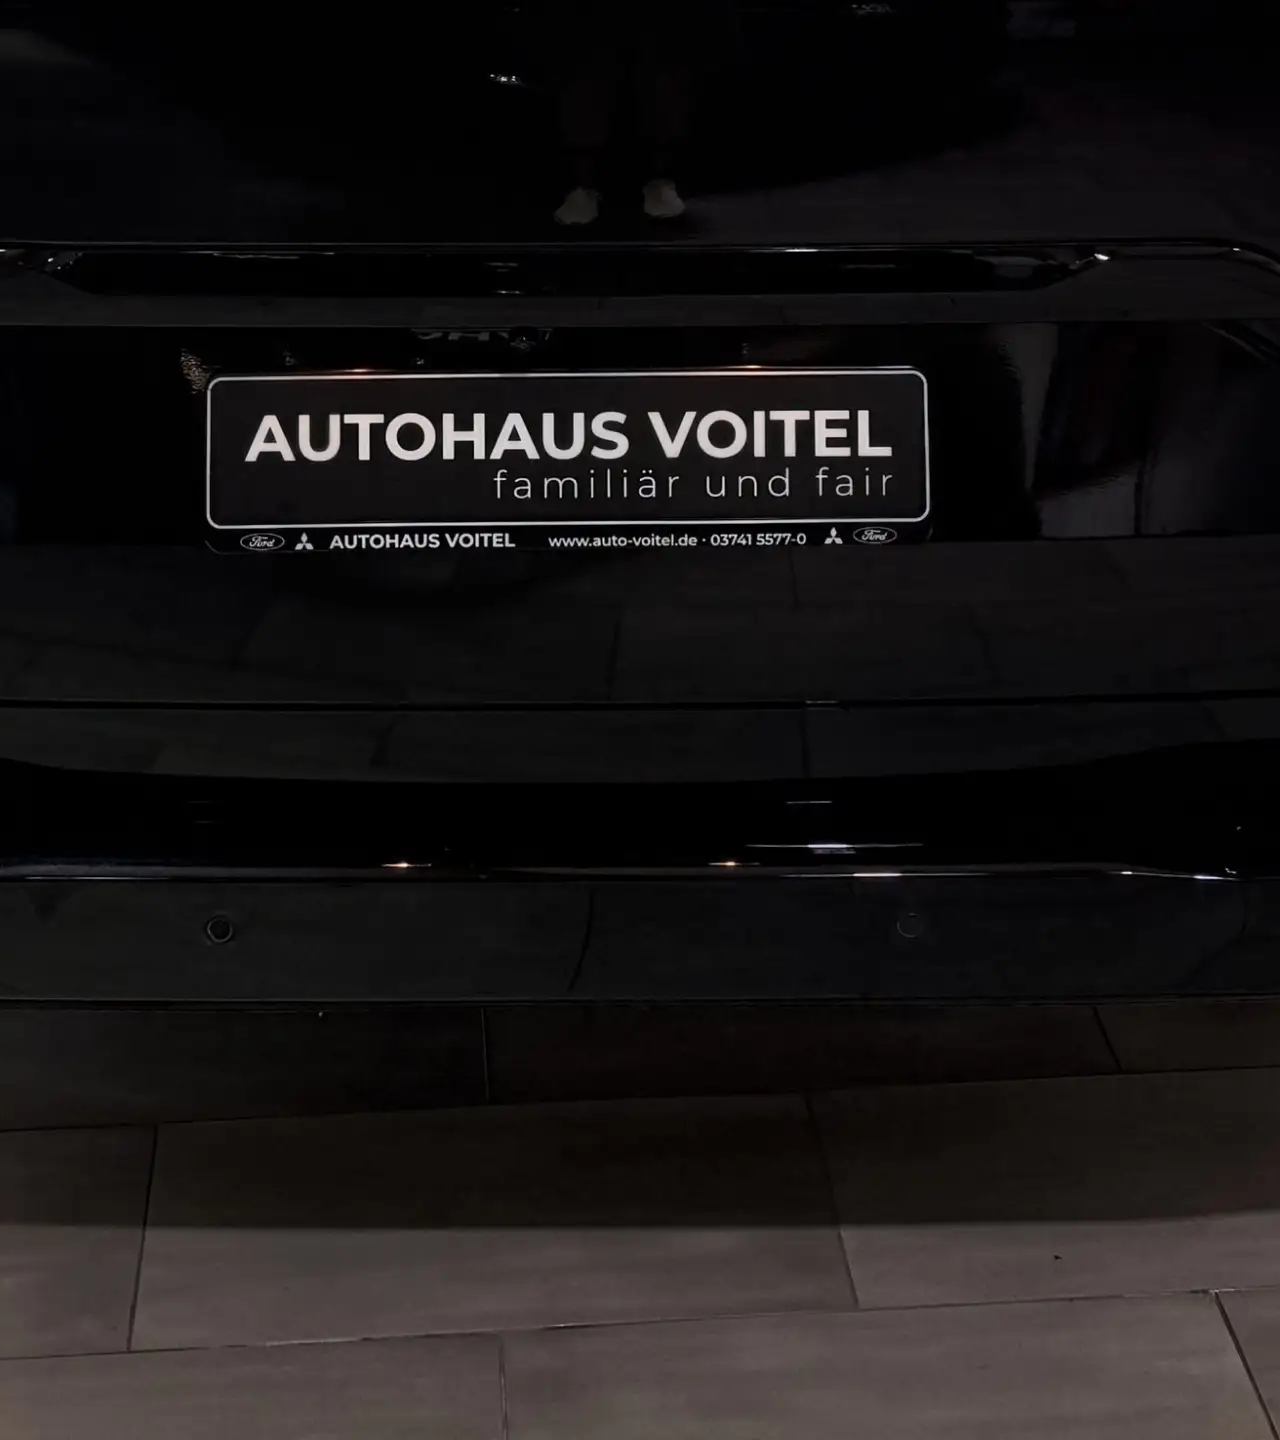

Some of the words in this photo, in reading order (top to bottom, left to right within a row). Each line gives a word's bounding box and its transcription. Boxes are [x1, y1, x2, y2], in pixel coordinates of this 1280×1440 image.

[244, 411, 630, 462] AUTOHAUS
[647, 409, 893, 459] VOITEL
[493, 468, 680, 499] familiär
[706, 467, 790, 498] und
[815, 466, 893, 497] fair
[329, 533, 441, 549] AUTOHAUS
[444, 533, 516, 548] VOITEL
[548, 533, 698, 547] www.auto-voitel.de
[710, 533, 752, 546] 03741
[756, 533, 807, 546] 5577-0
